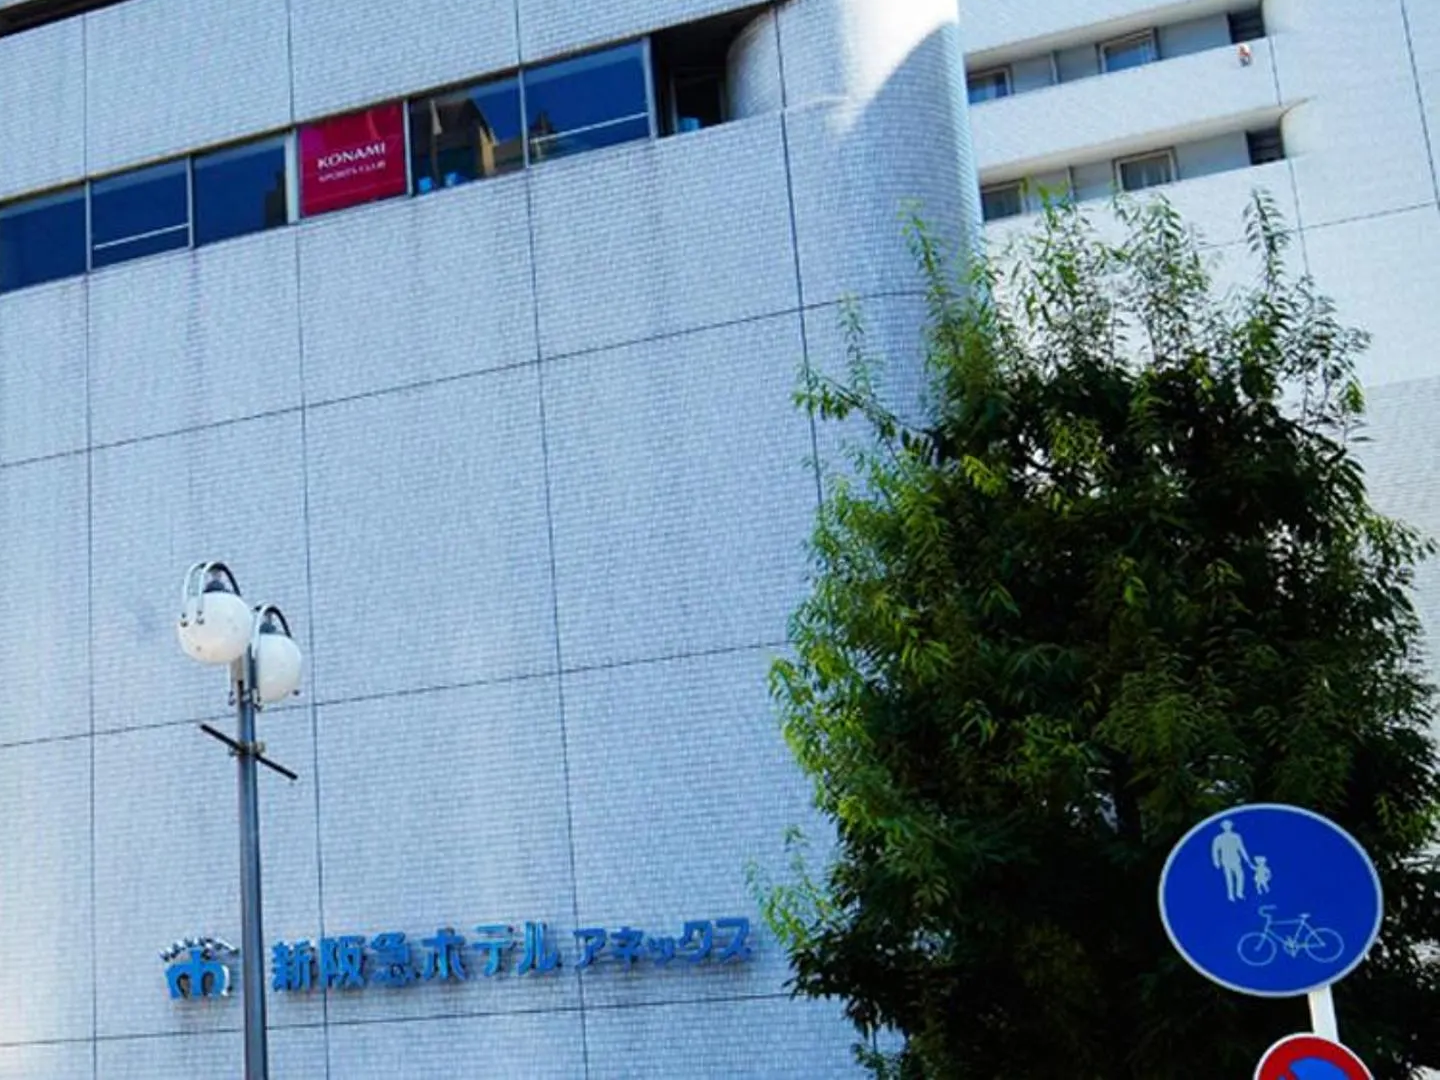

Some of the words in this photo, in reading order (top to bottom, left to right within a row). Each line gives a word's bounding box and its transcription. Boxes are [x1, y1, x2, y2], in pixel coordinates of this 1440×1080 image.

[317, 142, 386, 170] KONAMI
[271, 920, 563, 992] 新阪急ホテル
